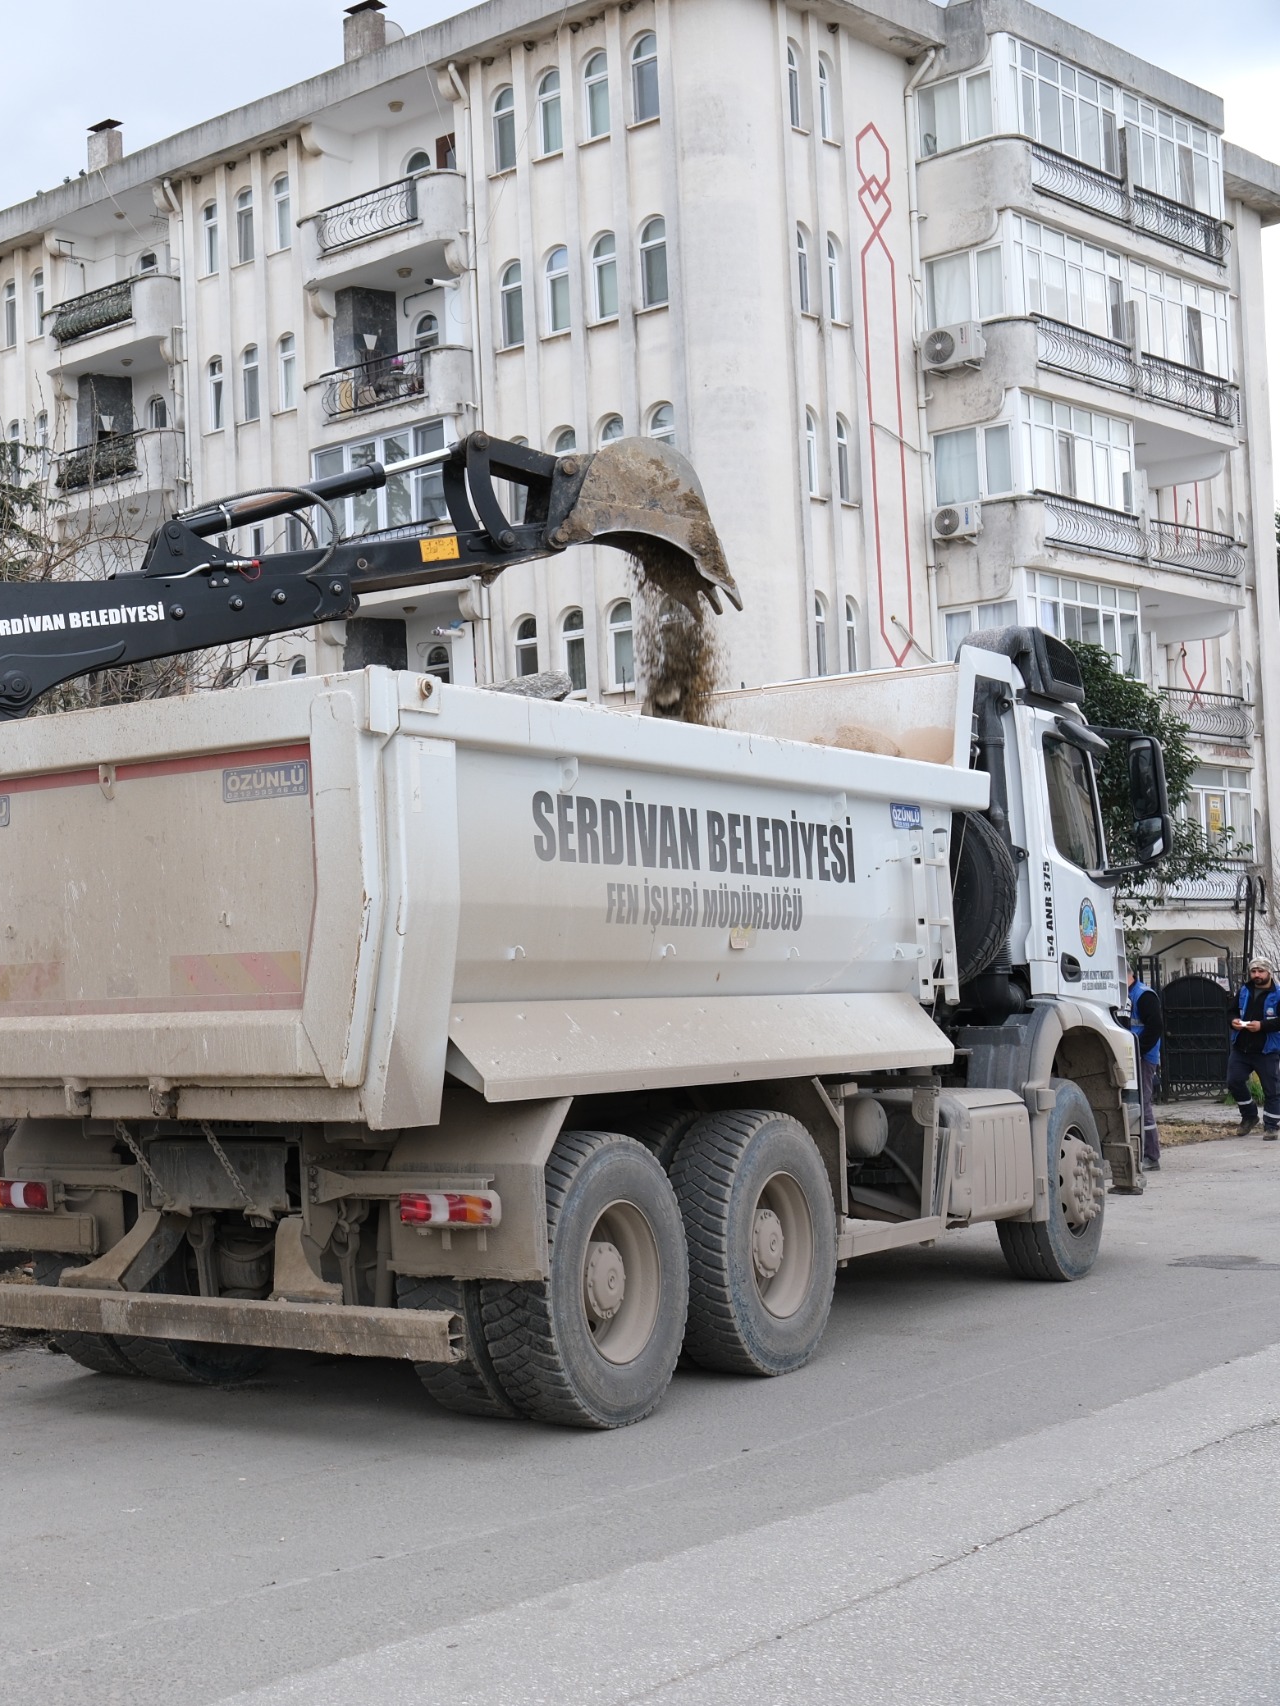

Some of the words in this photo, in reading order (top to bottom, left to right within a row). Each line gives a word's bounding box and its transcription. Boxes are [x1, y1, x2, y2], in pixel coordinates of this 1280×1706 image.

[68, 601, 166, 630] BELEDİYESİ
[226, 764, 305, 793] ÖZÜNLÜ
[892, 805, 920, 823] ÖZÜNLÜ
[532, 789, 702, 871] SERDİVAN
[706, 810, 856, 884] BELEDİYESİ
[1042, 861, 1051, 892] 375
[605, 882, 639, 925] FEN
[642, 877, 699, 933] İŞLERİ
[702, 882, 803, 932] MÜDÜRLÜĞÜ
[1045, 896, 1054, 931] ANR
[1047, 934, 1055, 957] 54
